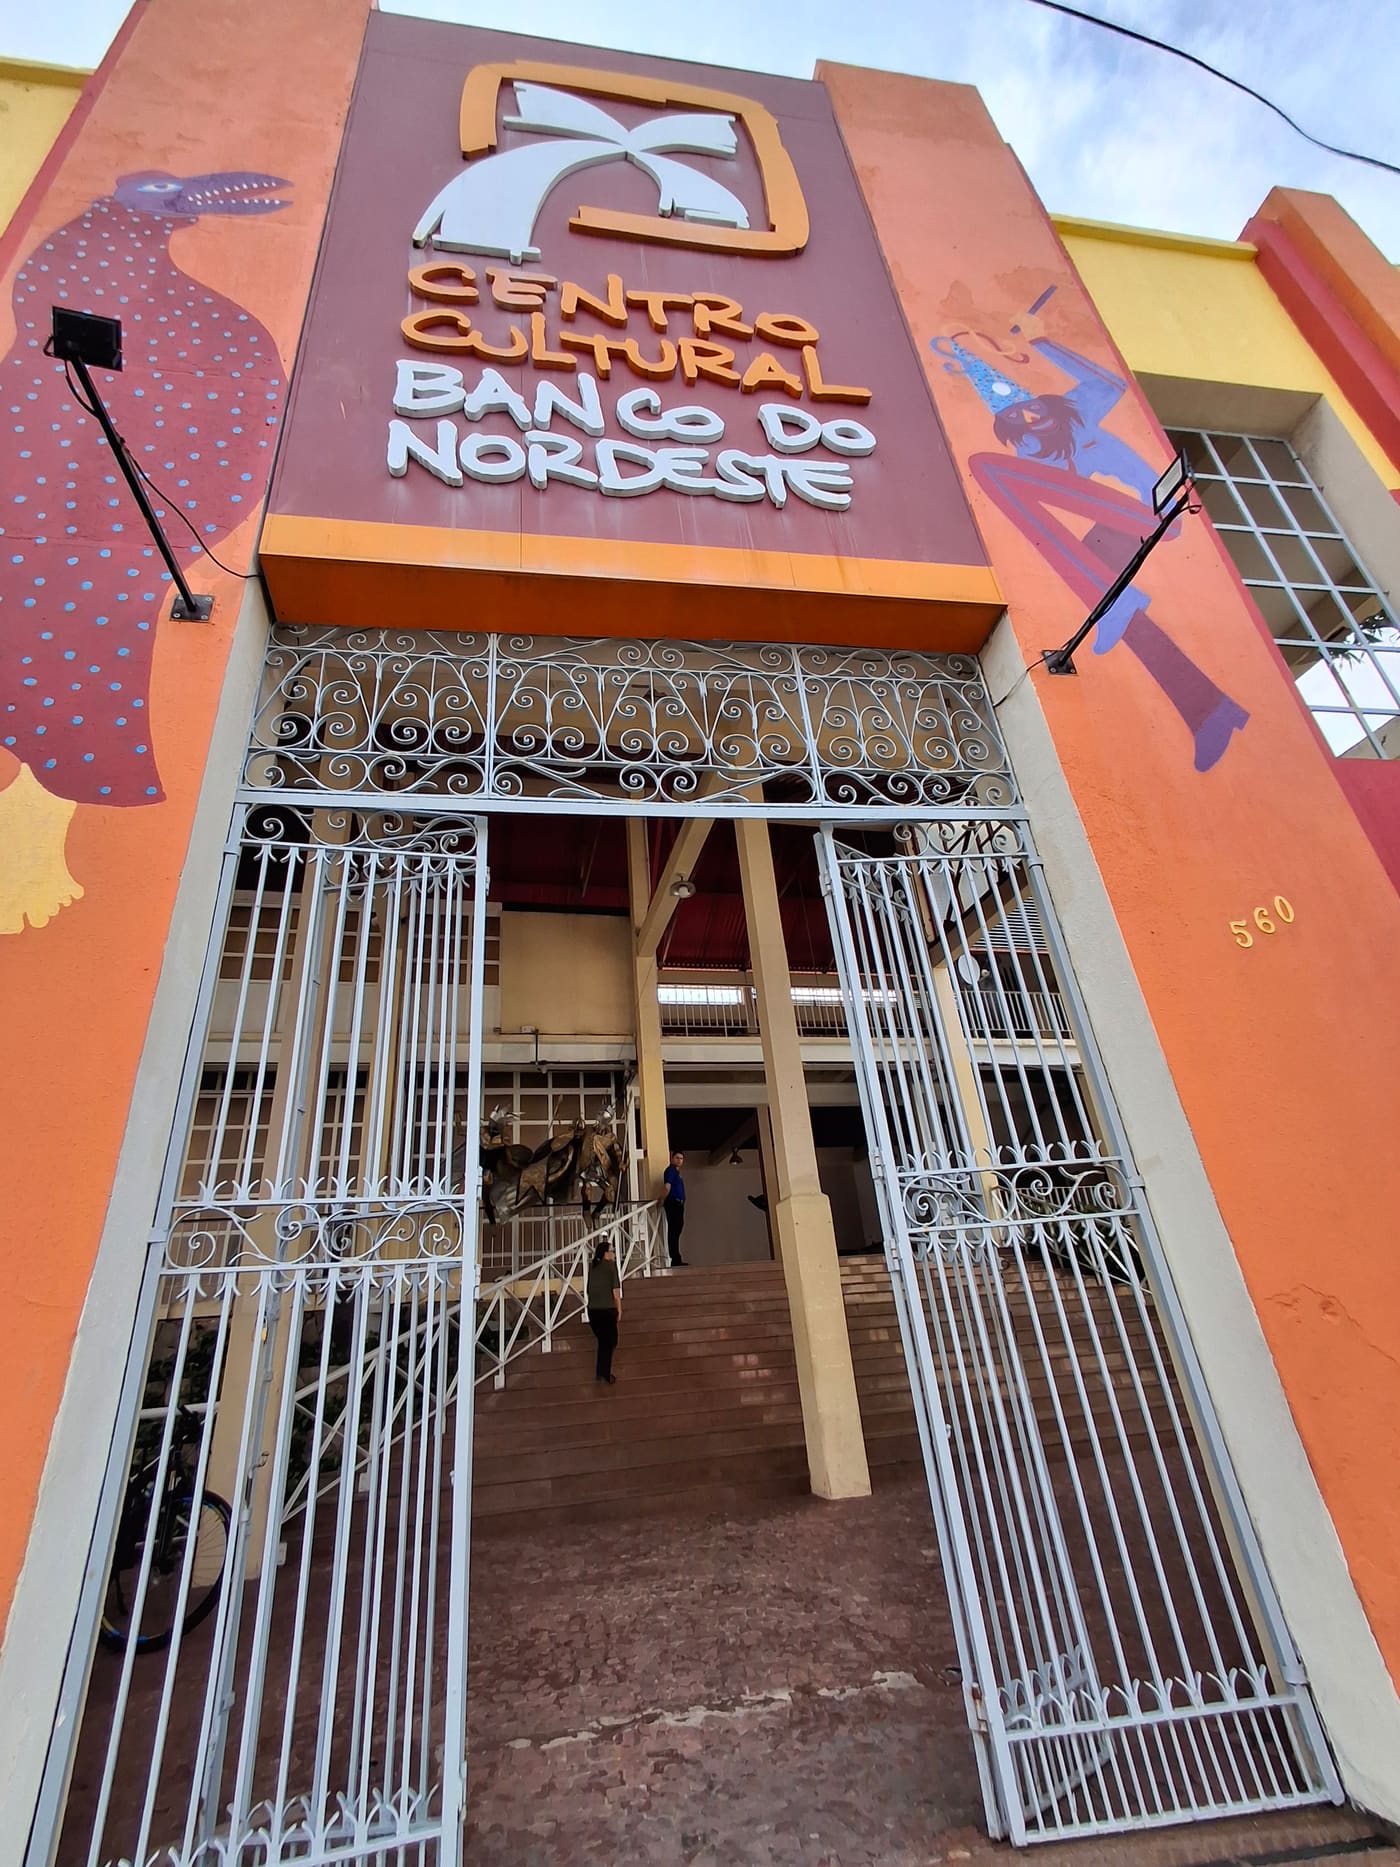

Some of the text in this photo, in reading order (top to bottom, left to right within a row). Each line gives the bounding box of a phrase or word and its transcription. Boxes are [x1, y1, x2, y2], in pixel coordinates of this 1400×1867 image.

[408, 261, 819, 347] CENTRO
[401, 309, 872, 403] CULTURAL
[393, 359, 877, 457] BANCO DO
[387, 420, 854, 511] NORDESTE
[1229, 895, 1295, 948] 560
